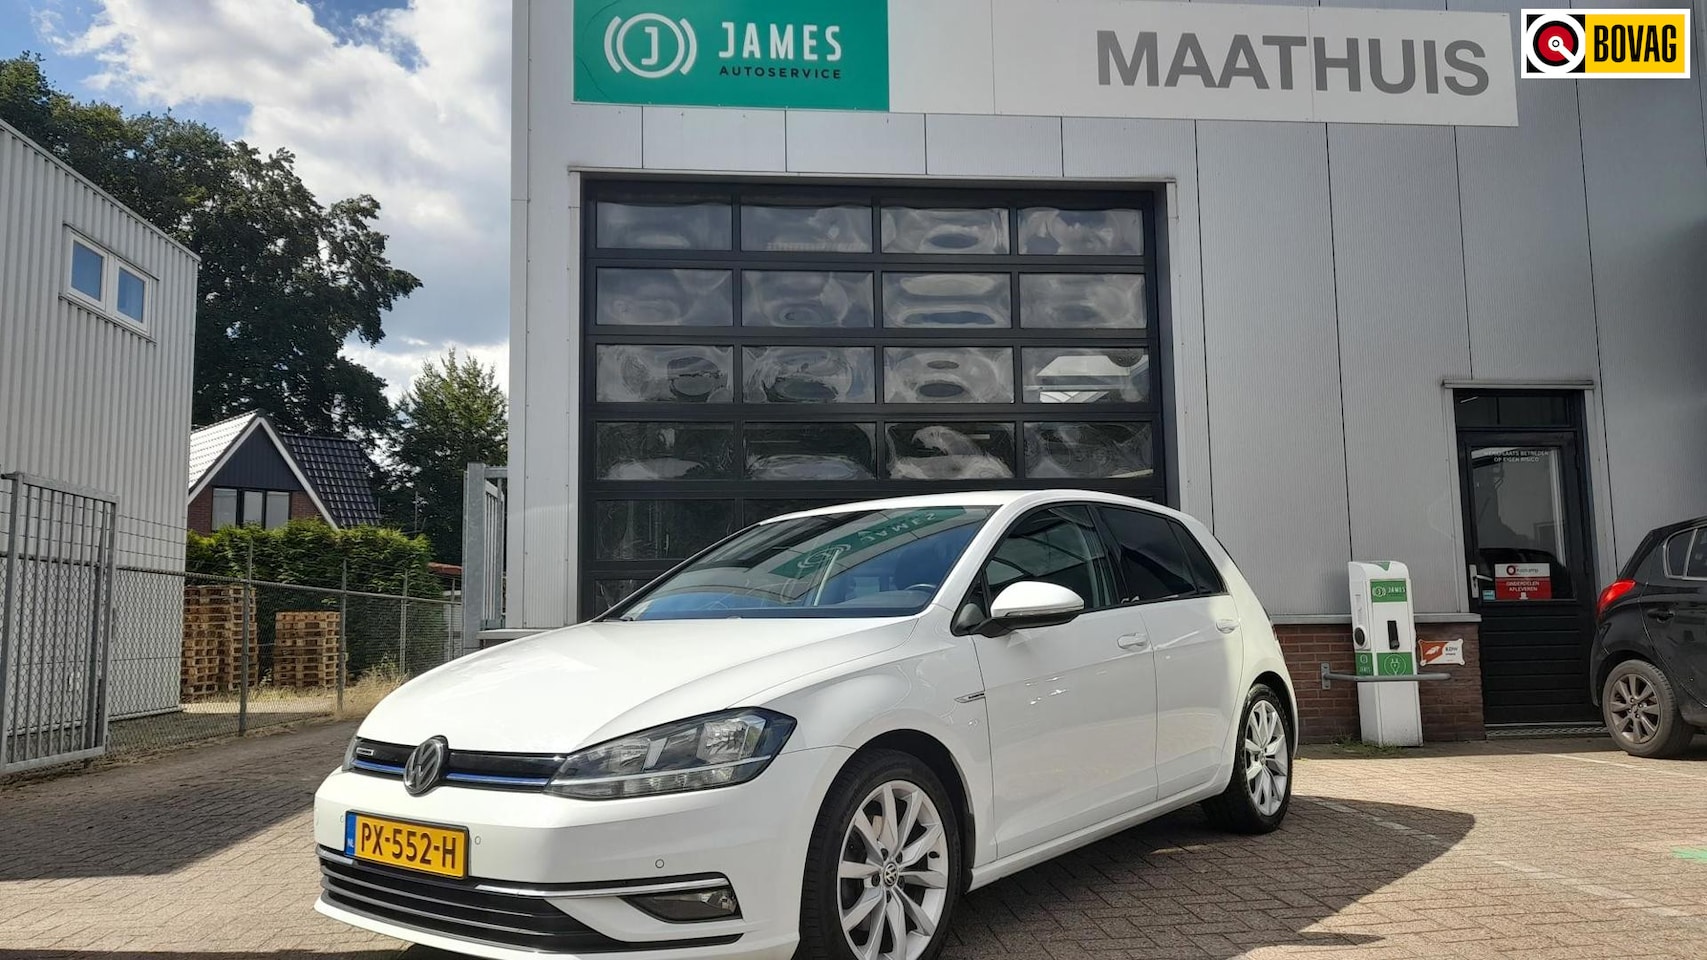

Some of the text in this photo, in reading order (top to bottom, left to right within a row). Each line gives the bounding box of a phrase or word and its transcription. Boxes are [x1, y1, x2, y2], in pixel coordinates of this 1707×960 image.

[718, 21, 842, 62] JAMES
[1096, 30, 1490, 96] MAATHUIS
[719, 66, 841, 79] AUTOSERVICE
[361, 822, 457, 869] PX-552-H
